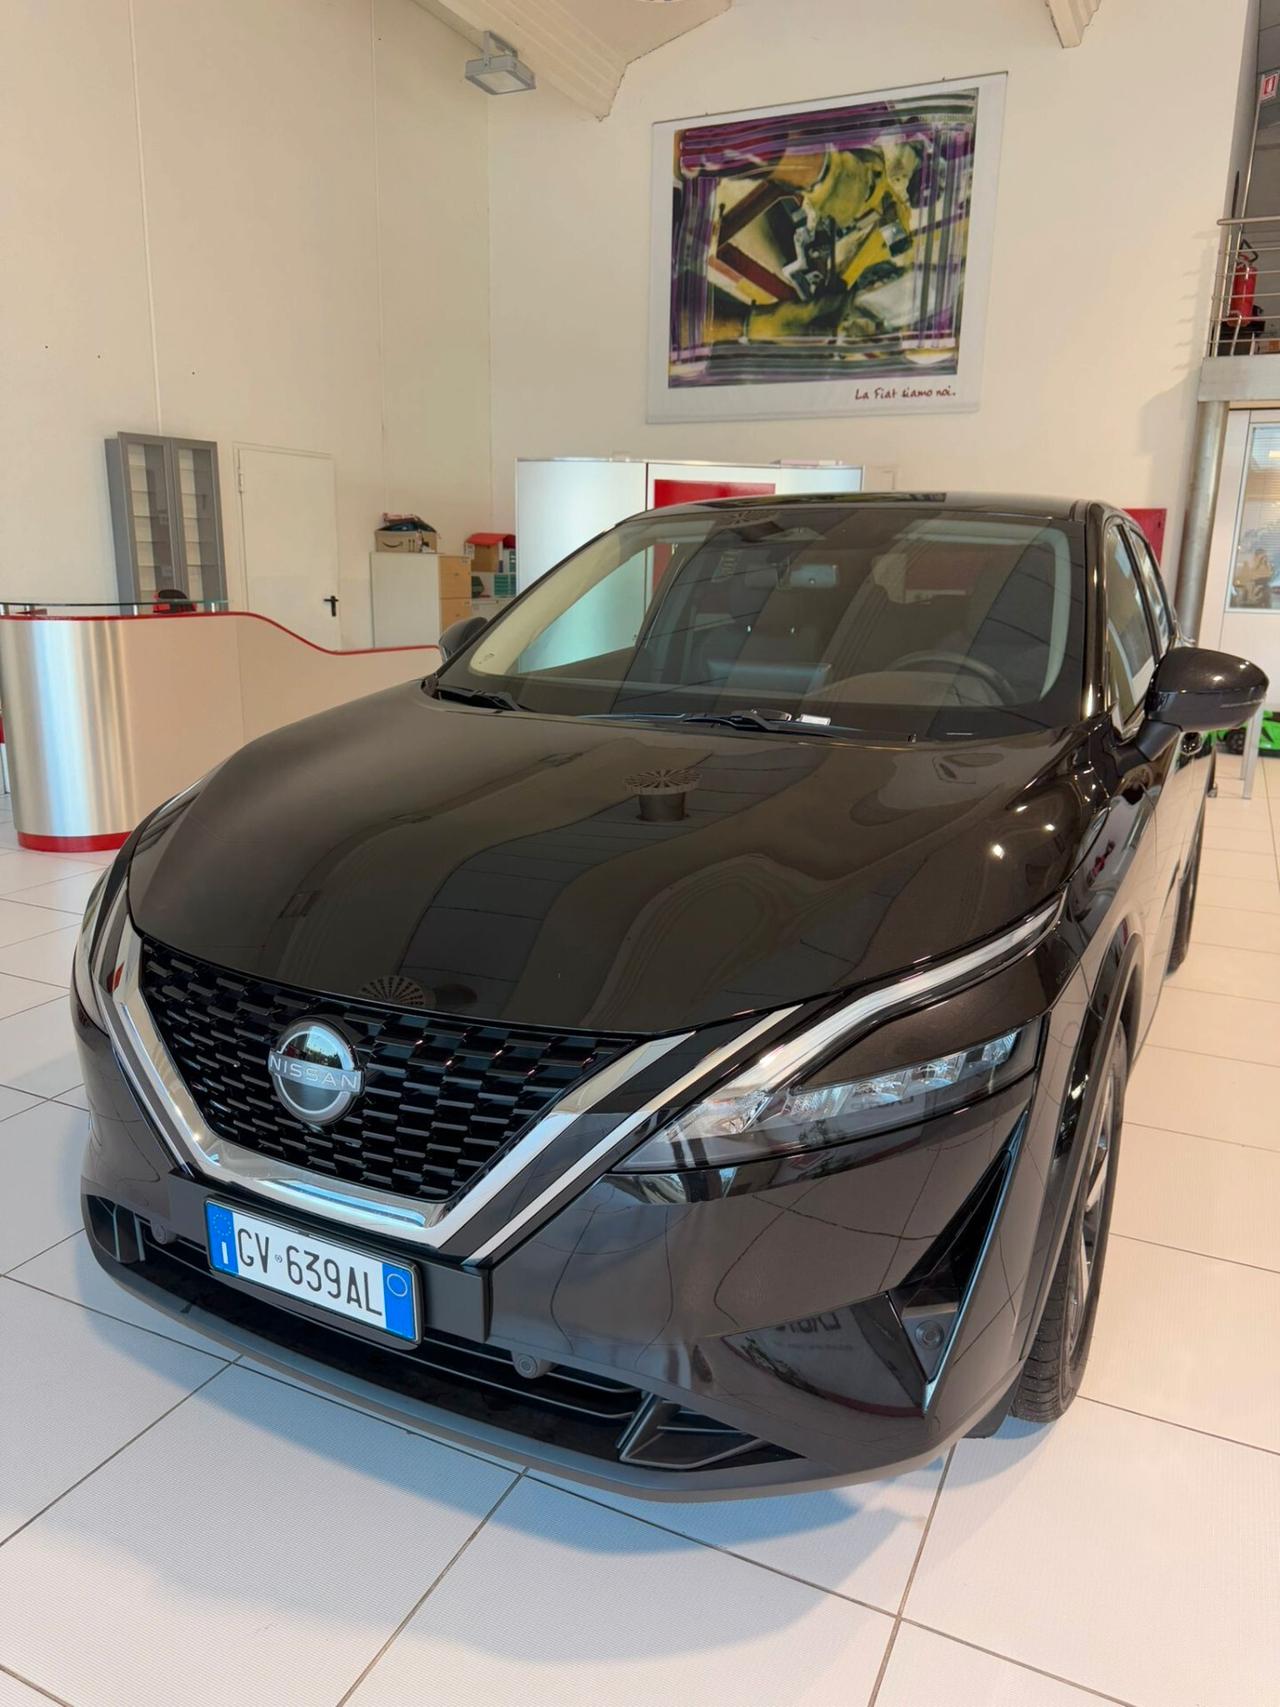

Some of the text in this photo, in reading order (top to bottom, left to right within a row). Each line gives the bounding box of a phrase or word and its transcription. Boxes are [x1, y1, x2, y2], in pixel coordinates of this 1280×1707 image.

[855, 388, 869, 400] La
[874, 387, 895, 399] Fiat
[269, 1054, 357, 1089] NISSAN
[237, 1228, 383, 1316] GV 639AL
